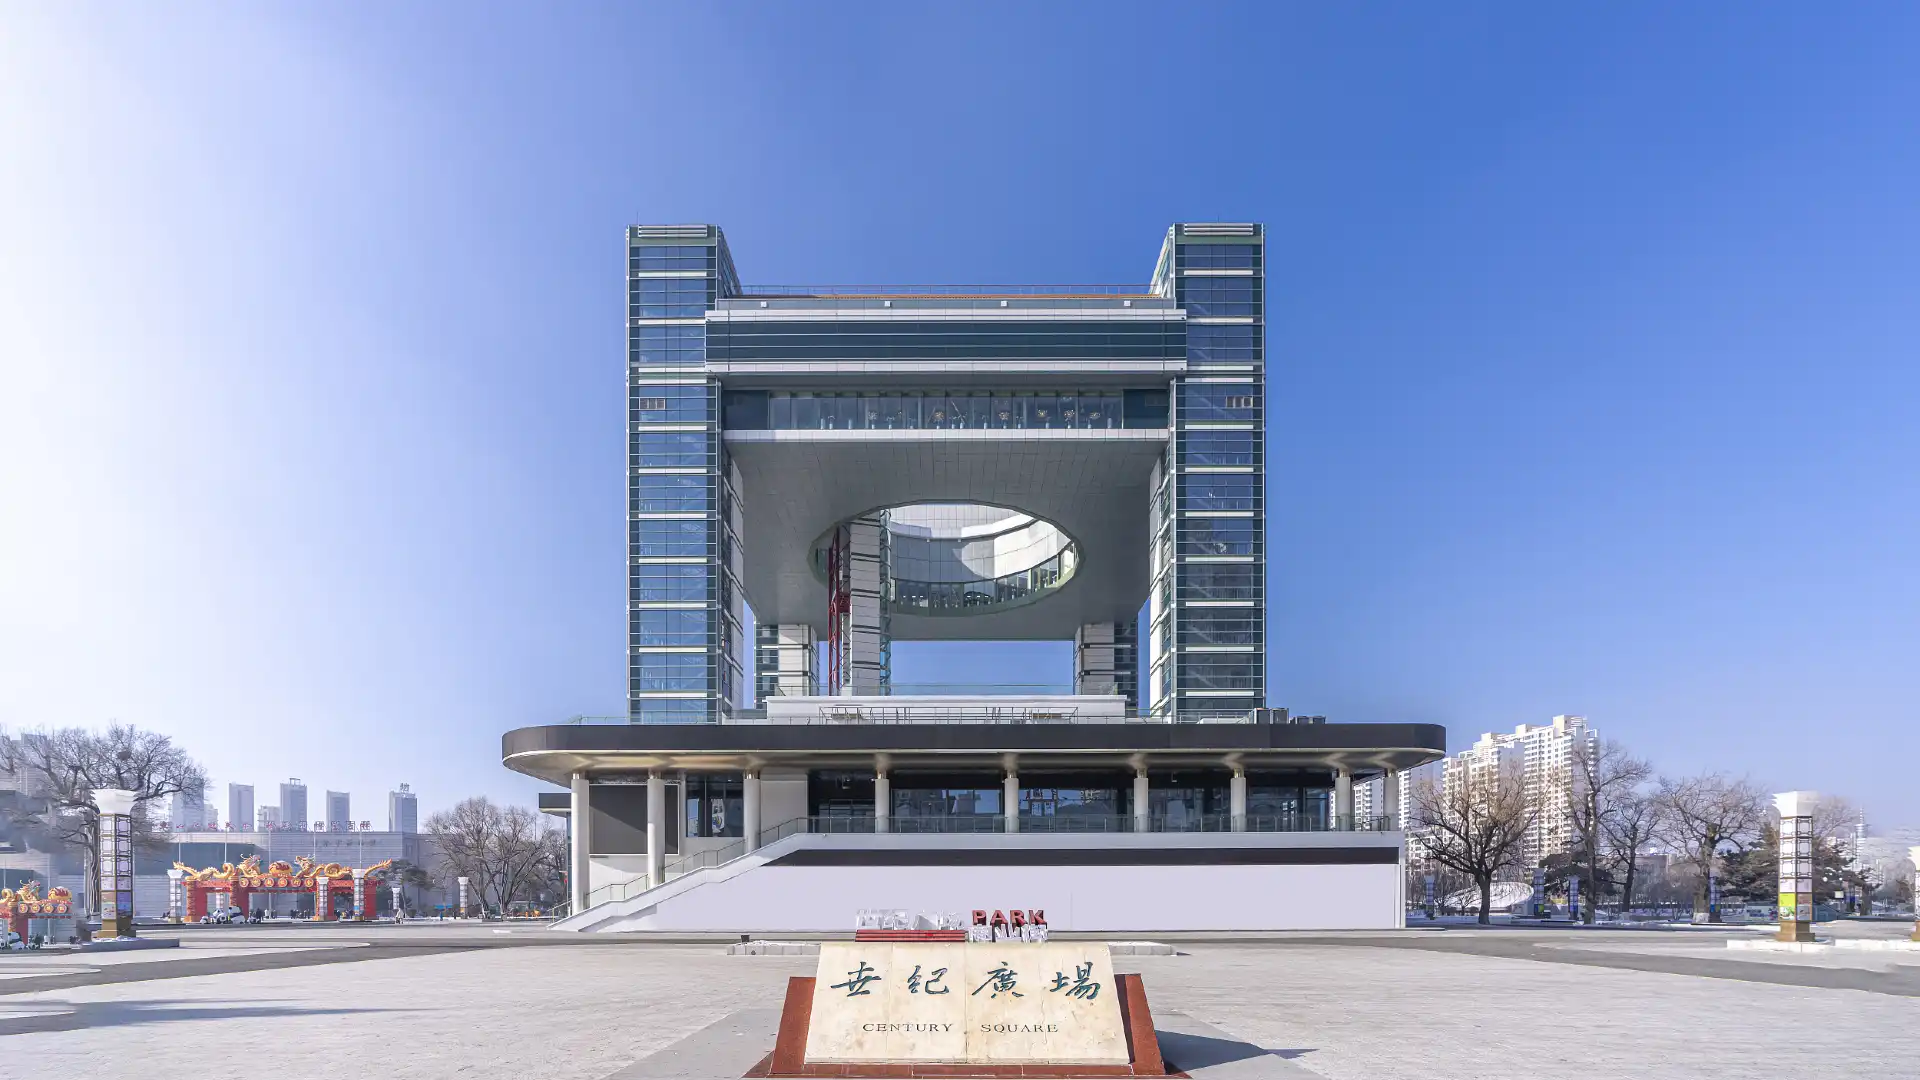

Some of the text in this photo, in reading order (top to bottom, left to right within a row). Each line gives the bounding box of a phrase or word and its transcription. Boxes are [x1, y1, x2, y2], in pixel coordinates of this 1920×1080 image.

[972, 909, 1048, 924] PARK
[862, 1023, 1059, 1033] CENTURY SQUARE
